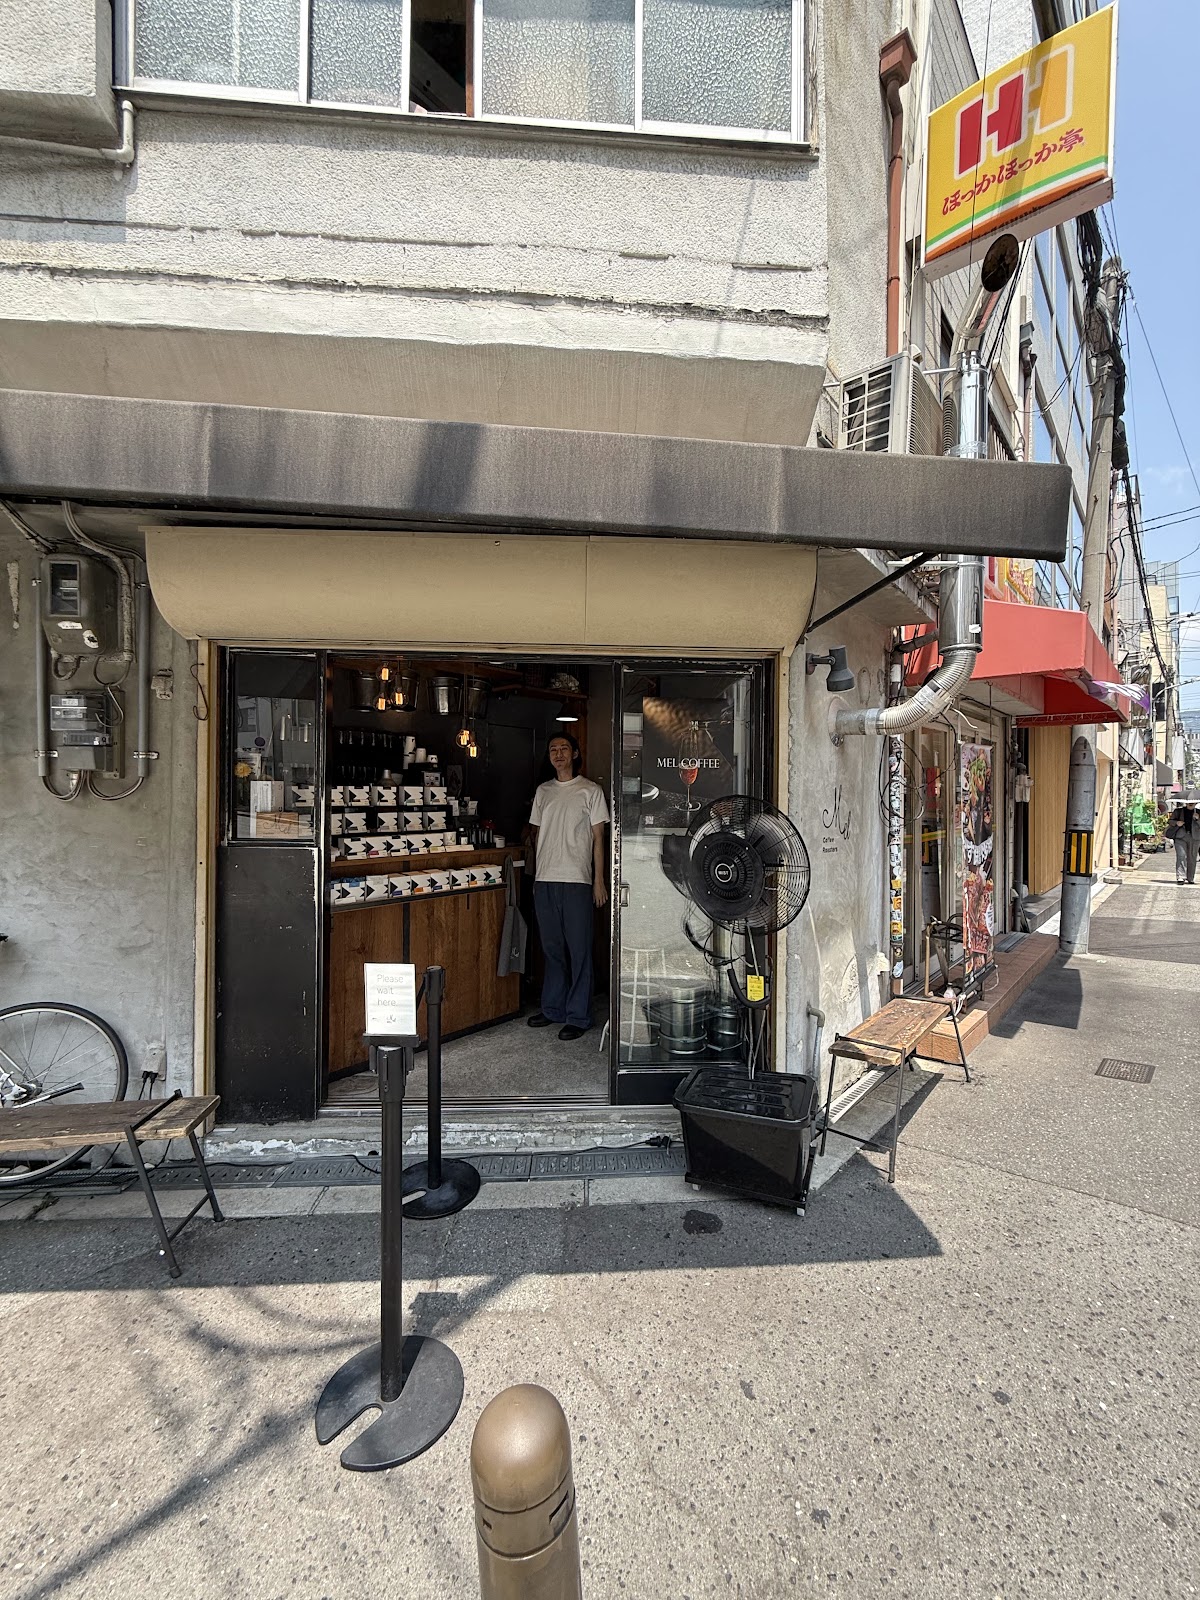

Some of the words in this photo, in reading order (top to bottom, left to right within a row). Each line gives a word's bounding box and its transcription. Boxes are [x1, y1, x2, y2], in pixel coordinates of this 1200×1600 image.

[941, 127, 1084, 216] ほっかほっか亭
[656, 757, 679, 768] MEL
[680, 757, 720, 769] COFFEE
[376, 973, 404, 983] Please
[376, 986, 394, 995] wait
